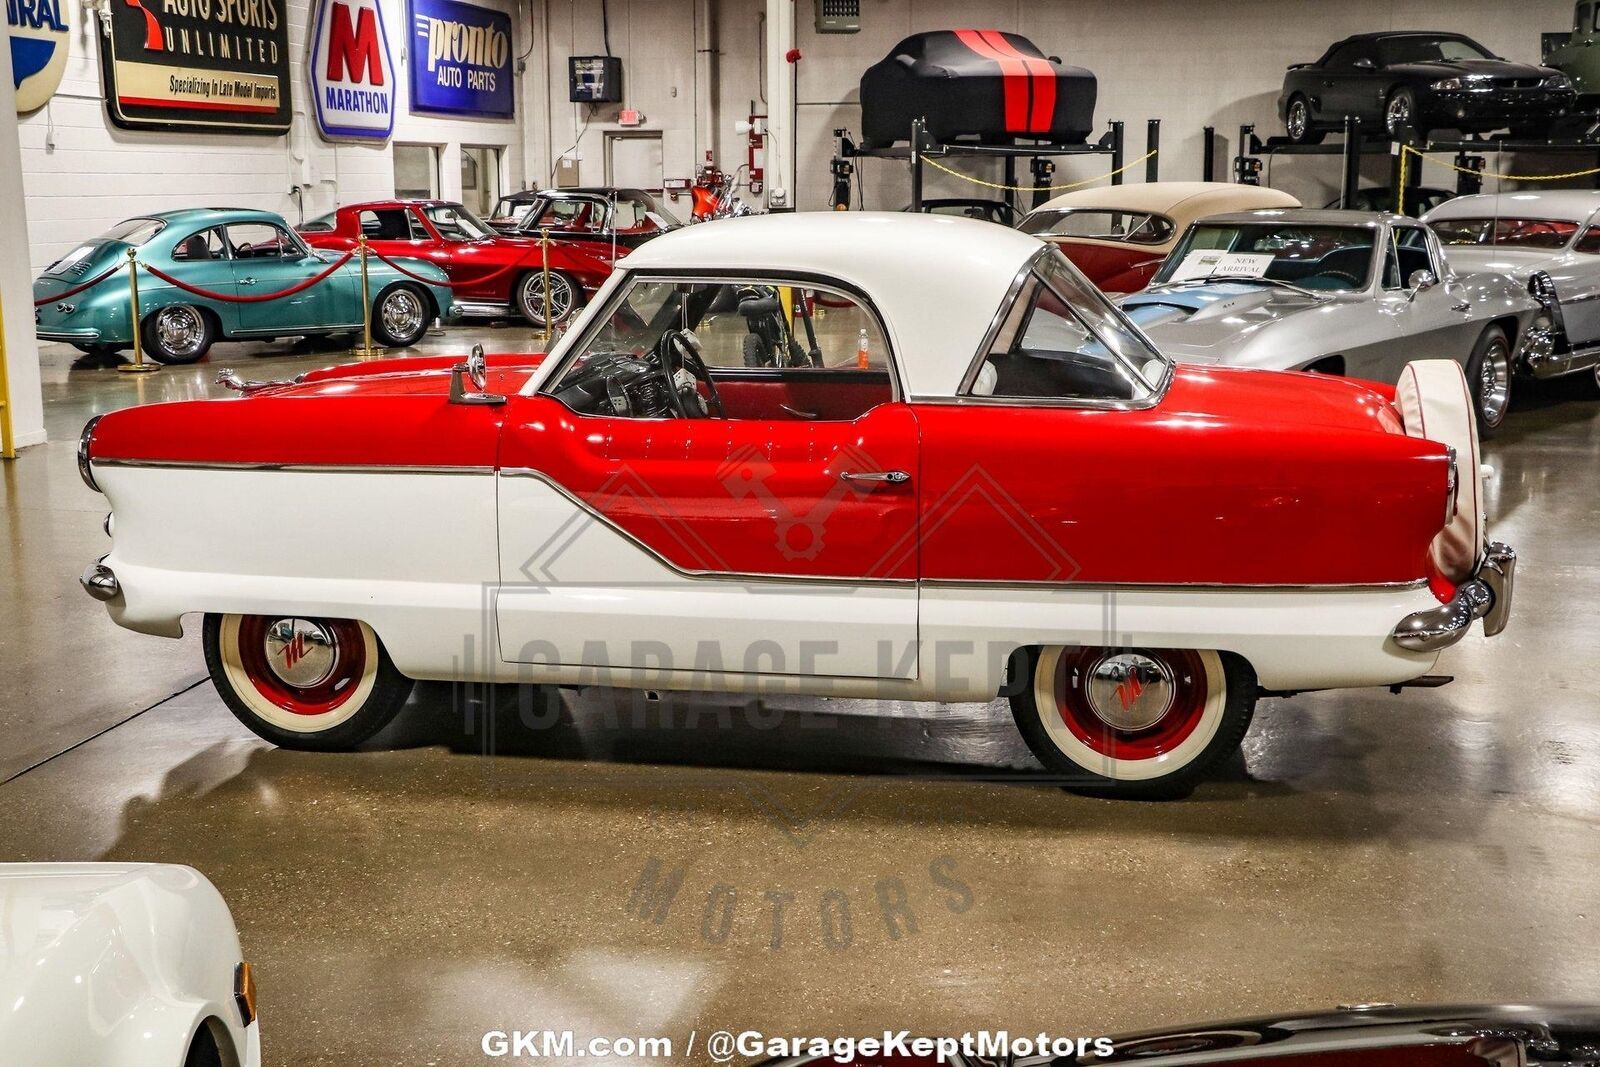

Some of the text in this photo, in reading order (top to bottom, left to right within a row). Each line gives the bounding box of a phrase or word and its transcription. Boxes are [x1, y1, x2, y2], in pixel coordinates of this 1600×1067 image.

[165, 26, 278, 64] UNLIMITED
[327, 2, 384, 86] M
[428, 17, 508, 72] pronto
[169, 75, 211, 97] Specializing
[219, 80, 233, 97] Late
[234, 80, 253, 98] Model
[437, 65, 496, 92] AUTO PARTS
[326, 87, 388, 114] MARATHON
[1221, 265, 1260, 273] ARRIVAL
